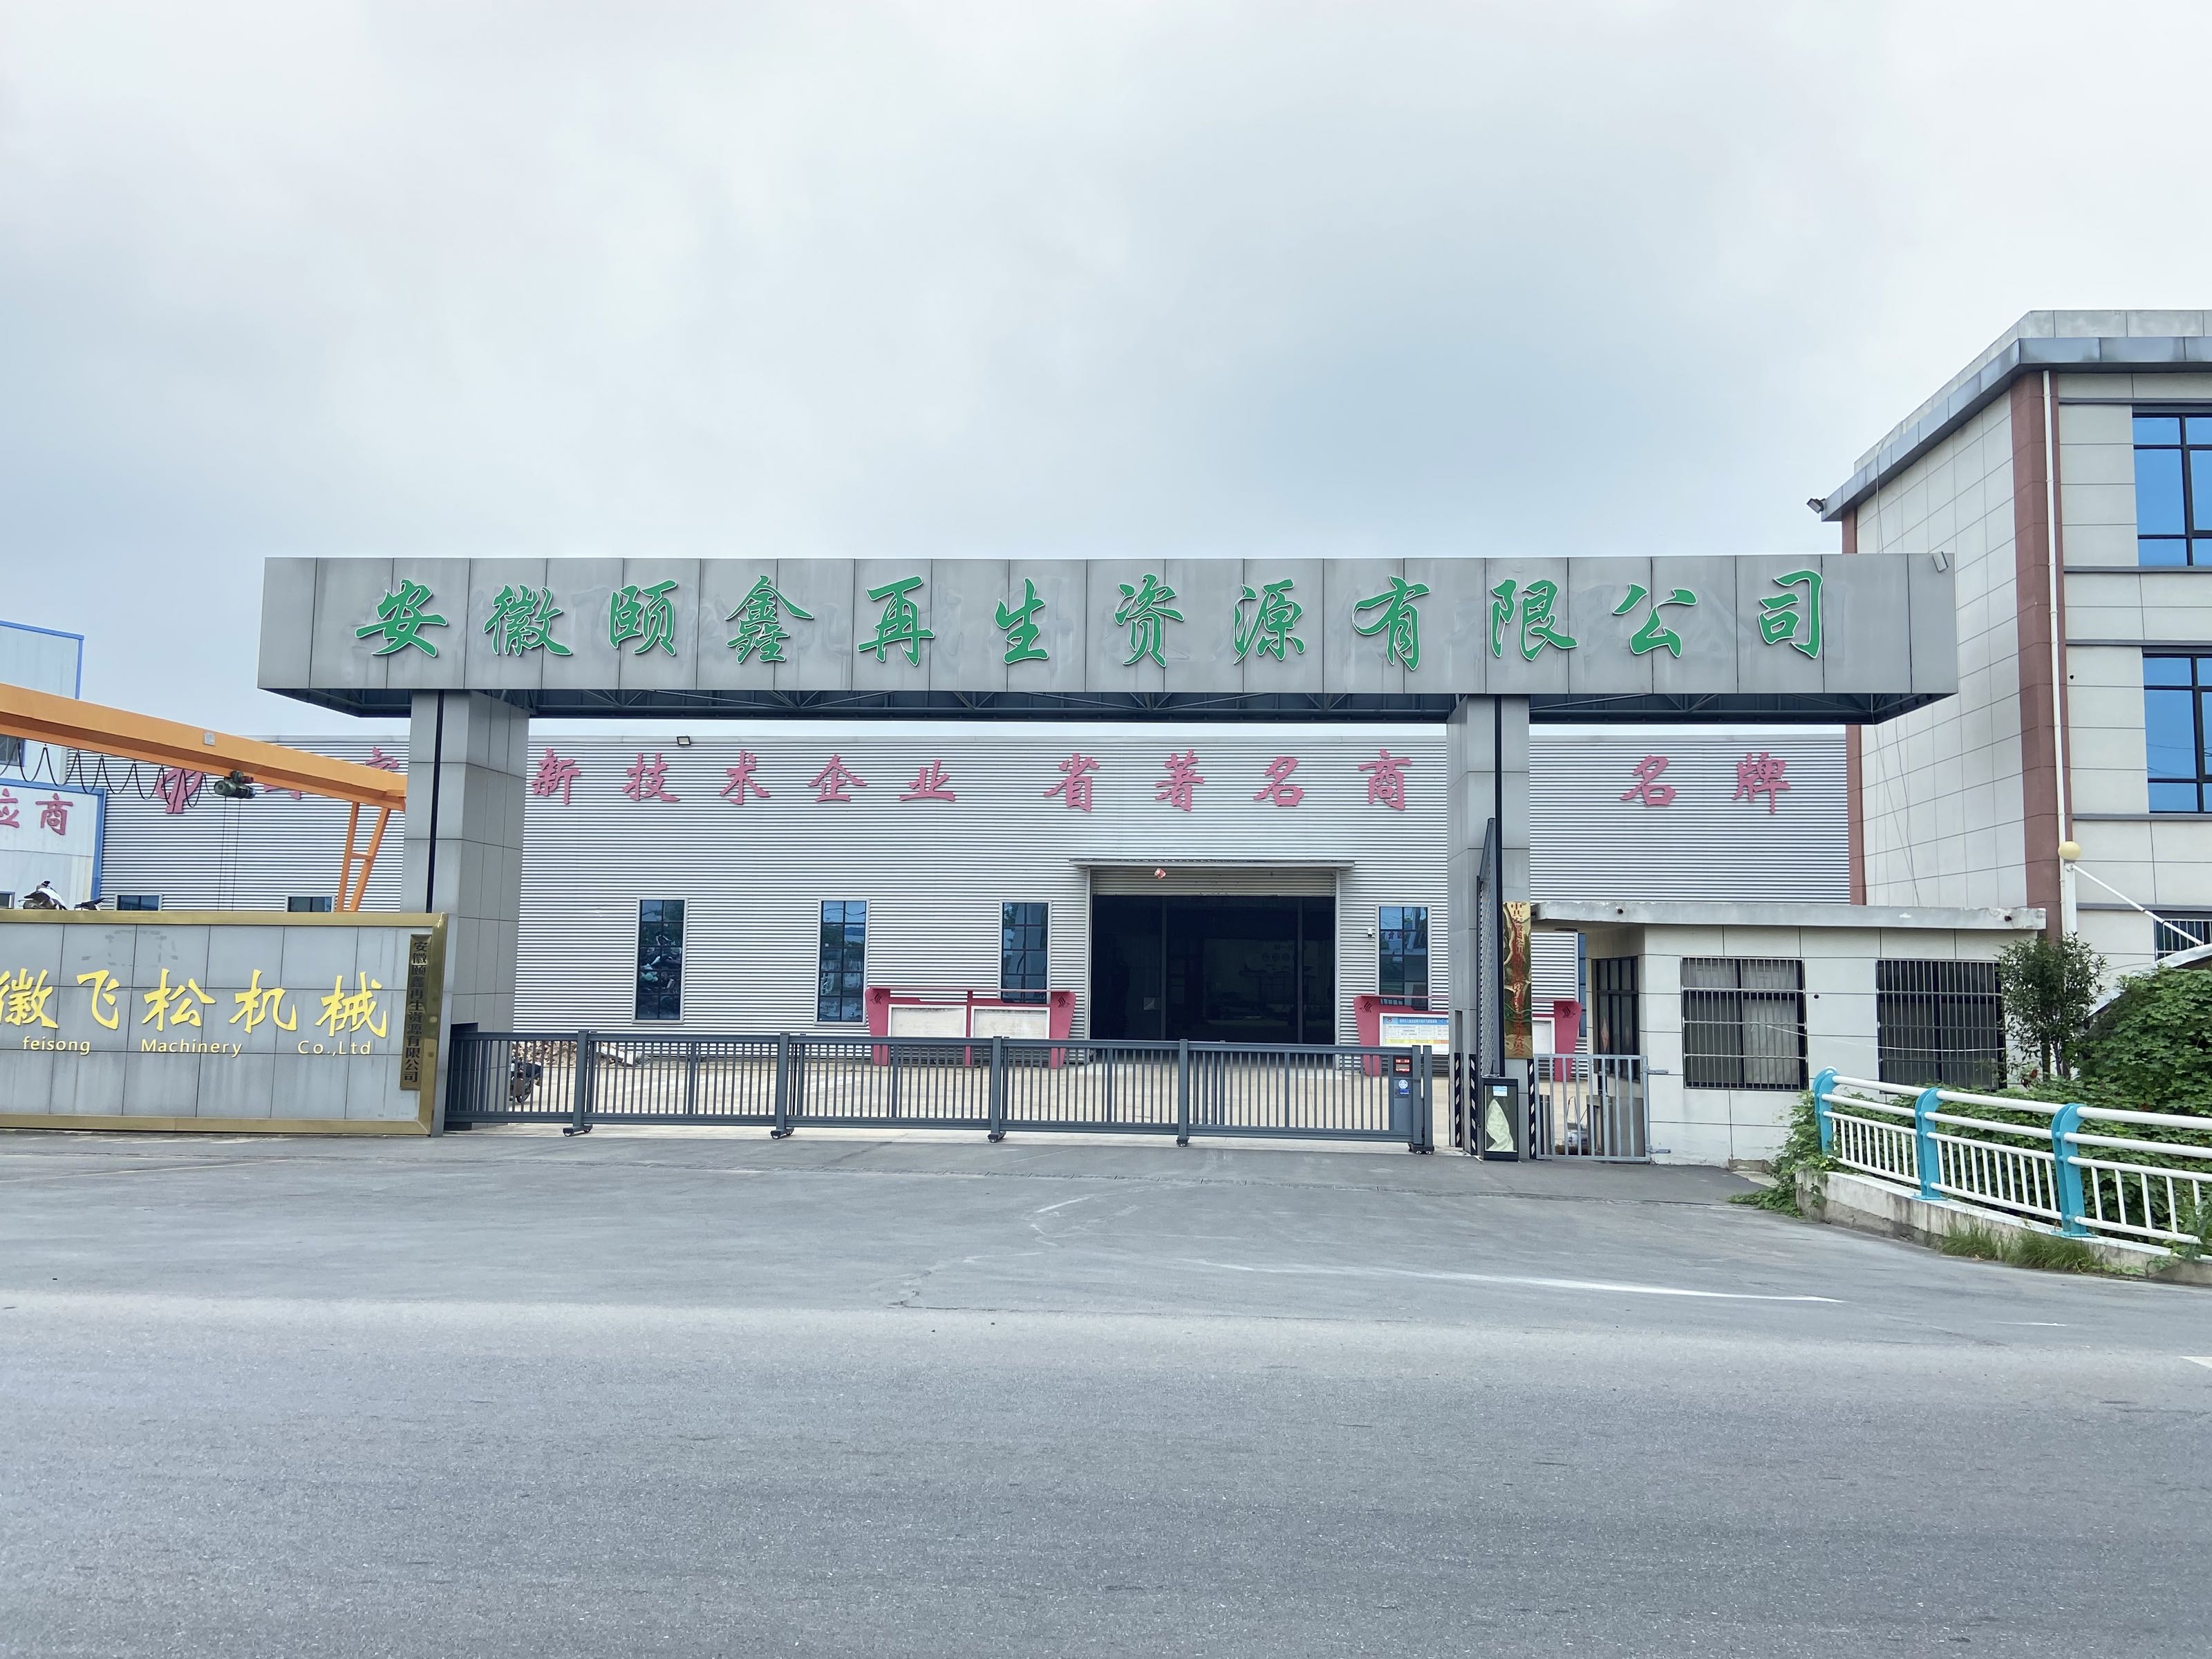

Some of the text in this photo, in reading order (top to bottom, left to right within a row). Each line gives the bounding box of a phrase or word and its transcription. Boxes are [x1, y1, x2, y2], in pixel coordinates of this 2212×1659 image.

[355, 569, 1824, 671] 安徽颐鑫再生资源有限公司
[1619, 752, 1791, 814] 名牌
[0, 968, 387, 1038] 徽飞松机械
[404, 941, 429, 1083] 安徽颐鑫再生资源有限公司
[23, 1035, 372, 1058] feisong Machinery Co.,Ltd
